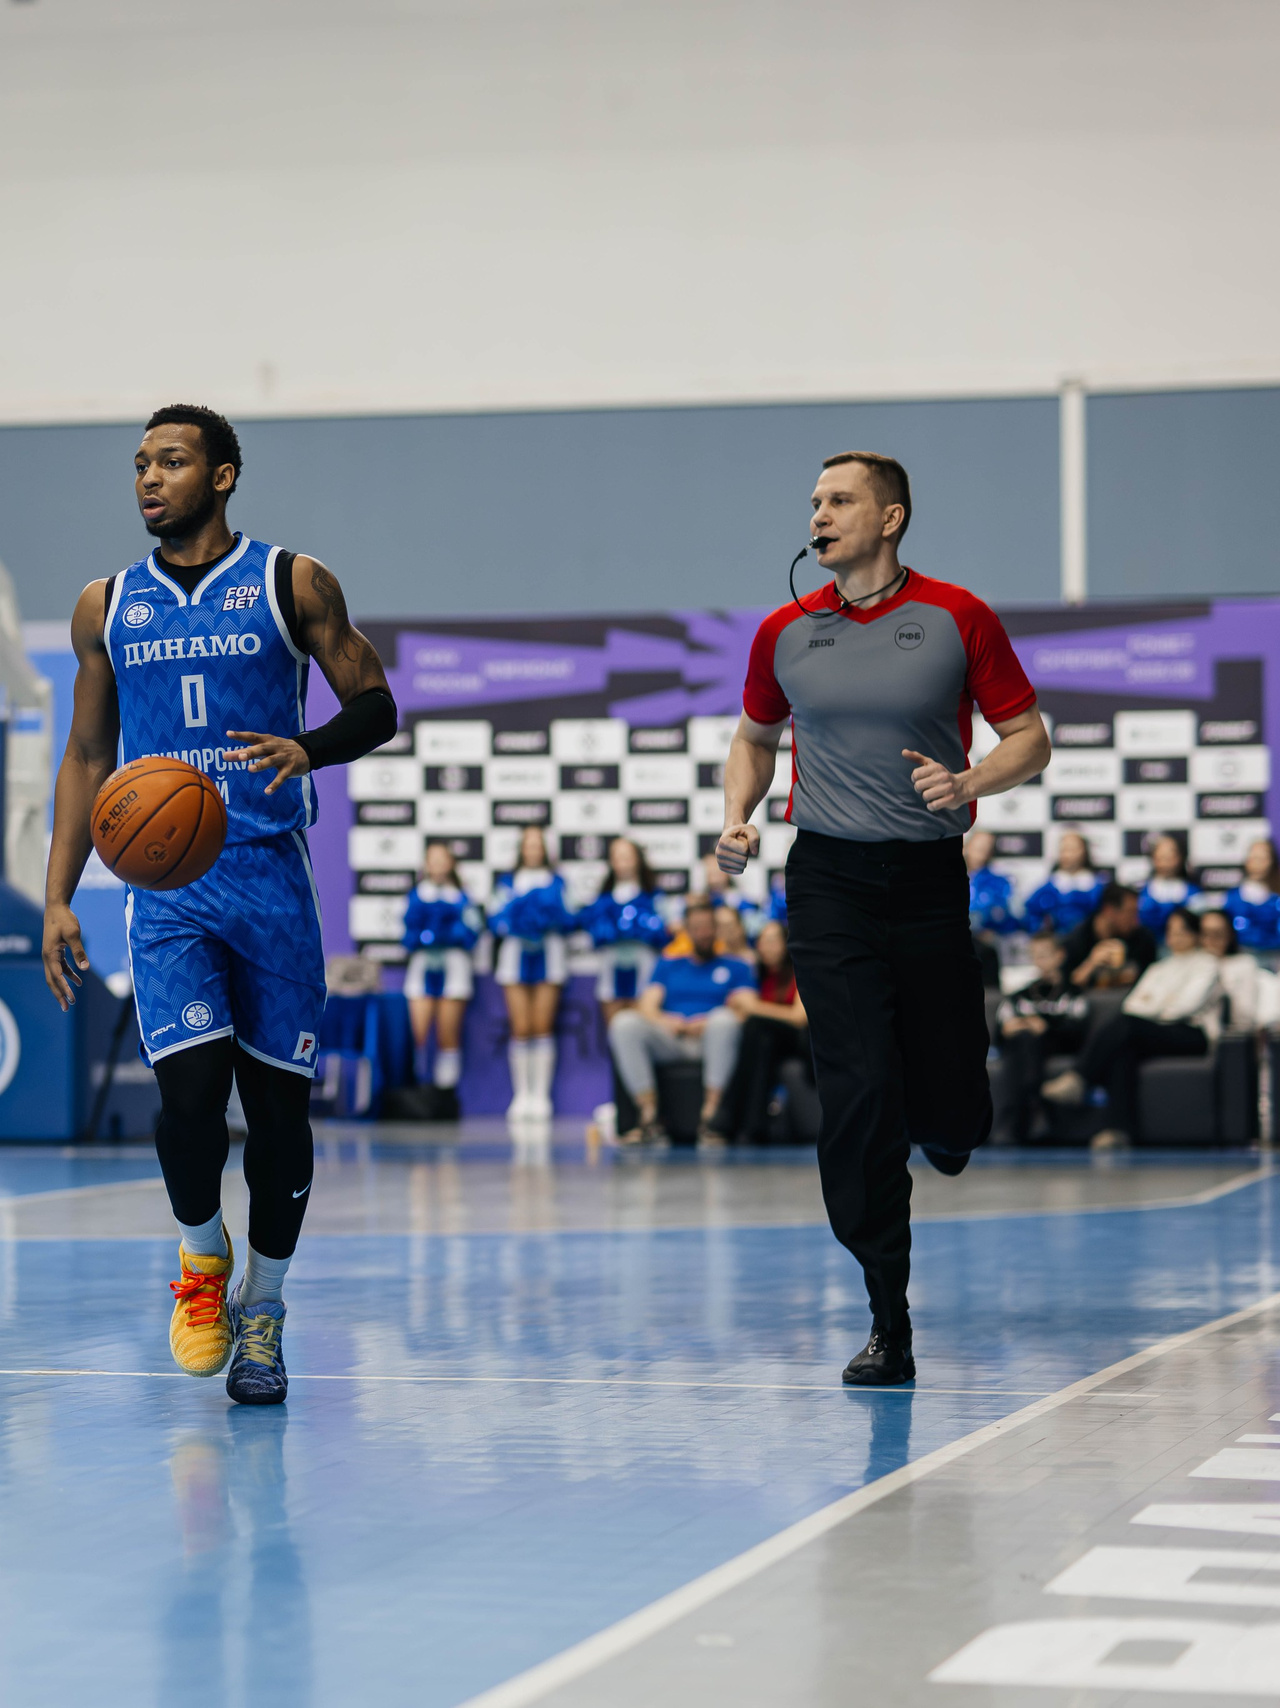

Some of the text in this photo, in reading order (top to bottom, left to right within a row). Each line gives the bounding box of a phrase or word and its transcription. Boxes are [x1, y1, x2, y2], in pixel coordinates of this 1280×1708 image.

[222, 596, 259, 611] BET
[225, 585, 262, 599] FON
[898, 632, 921, 641] РФБ
[123, 632, 262, 669] ДИНАМО
[181, 674, 207, 728] 0
[141, 746, 263, 773] МОРСКИ
[99, 790, 139, 839] JB-1000
